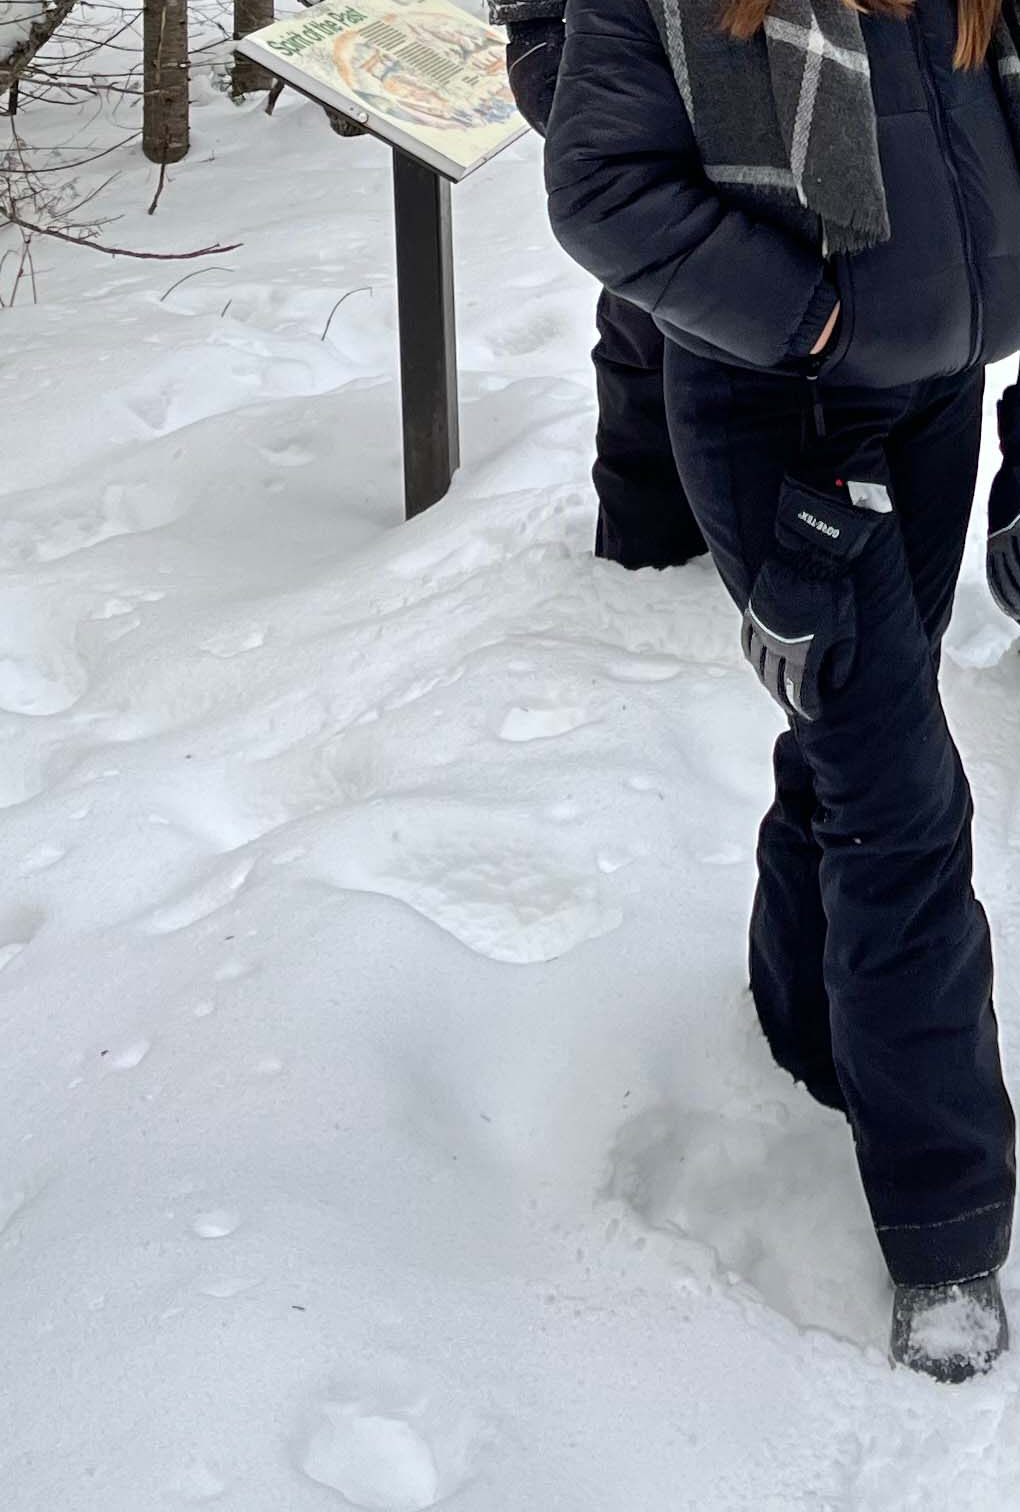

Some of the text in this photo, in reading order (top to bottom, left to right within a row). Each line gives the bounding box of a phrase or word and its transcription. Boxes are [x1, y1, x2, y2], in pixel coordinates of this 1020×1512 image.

[267, 30, 314, 57] Spirit
[311, 20, 343, 37] the
[328, 6, 368, 27] Past
[798, 511, 840, 539] GORE-TEX
